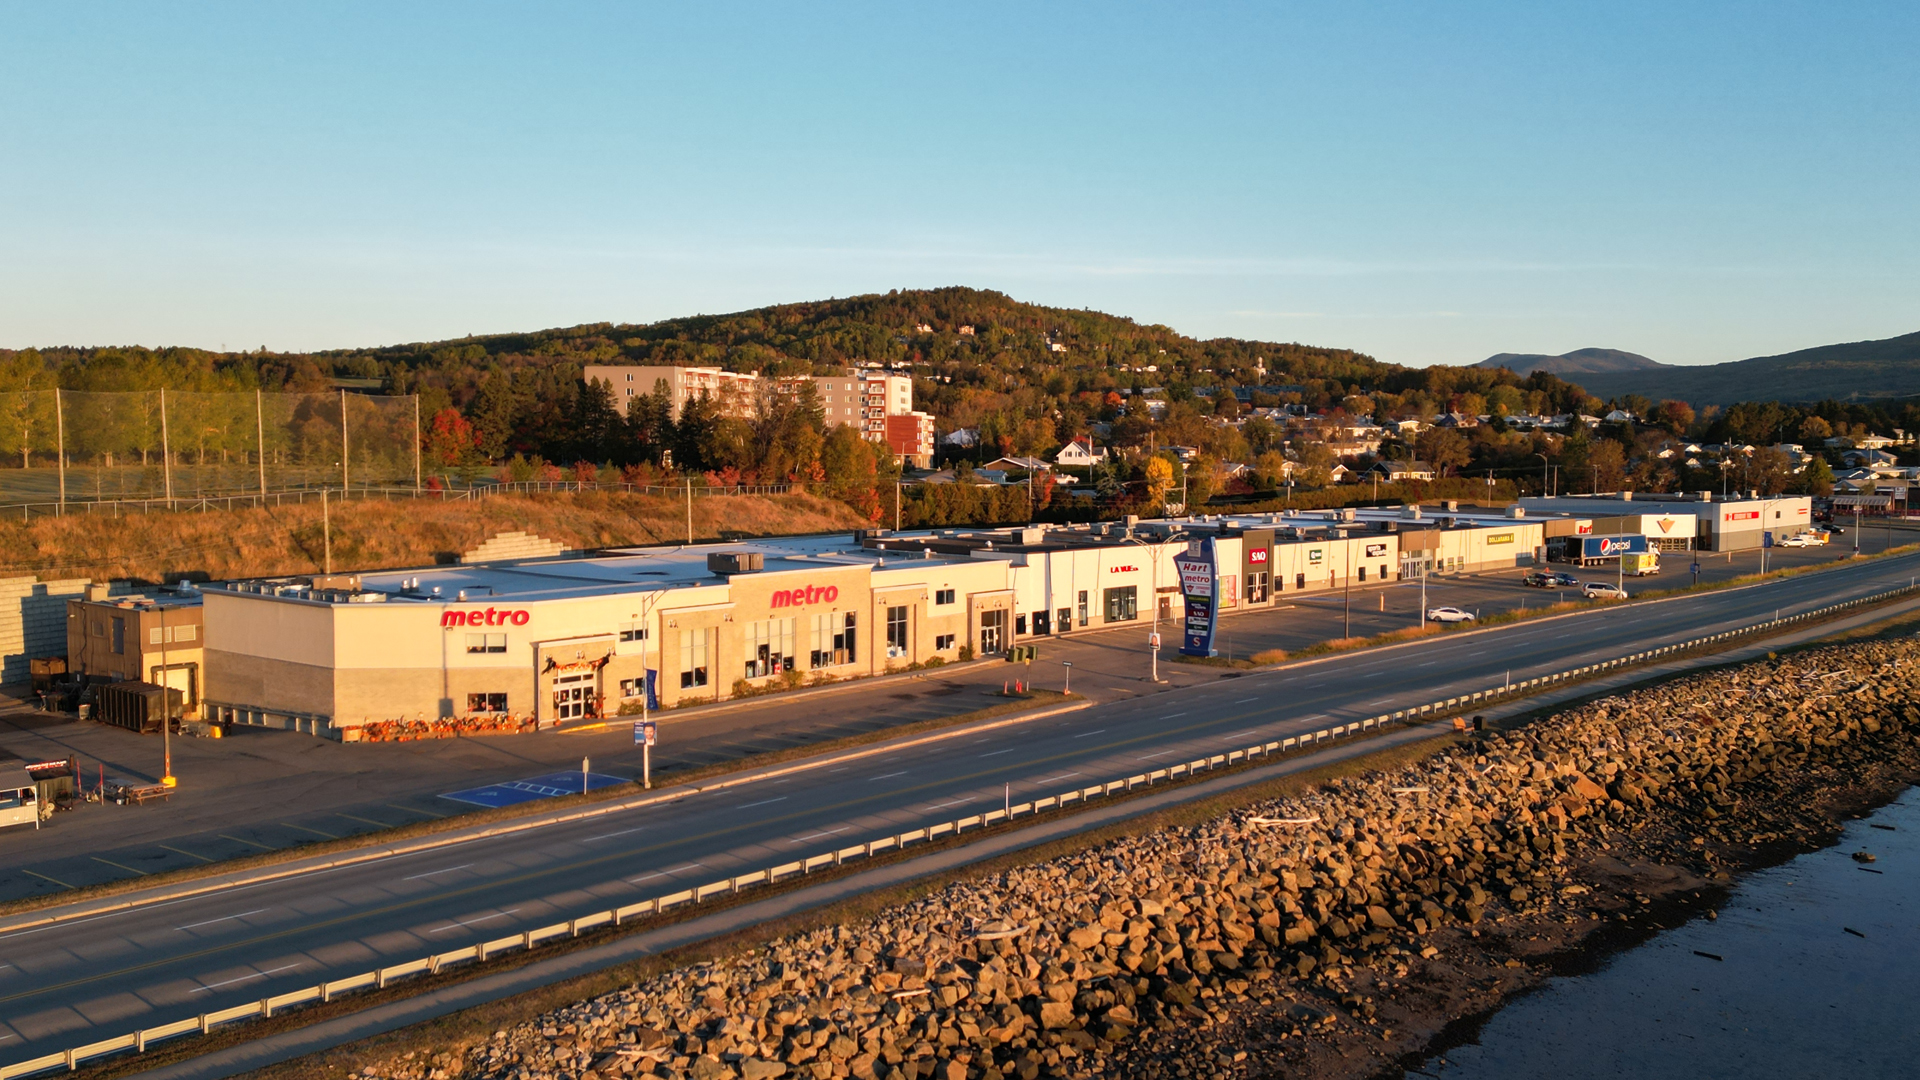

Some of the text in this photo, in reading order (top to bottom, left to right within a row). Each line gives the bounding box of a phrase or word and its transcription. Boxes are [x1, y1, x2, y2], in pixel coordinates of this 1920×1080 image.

[1611, 540, 1631, 552] pepsi
[1183, 563, 1207, 572] Hart
[1184, 575, 1210, 583] metro
[770, 584, 838, 608] metro
[440, 607, 529, 626] metro
